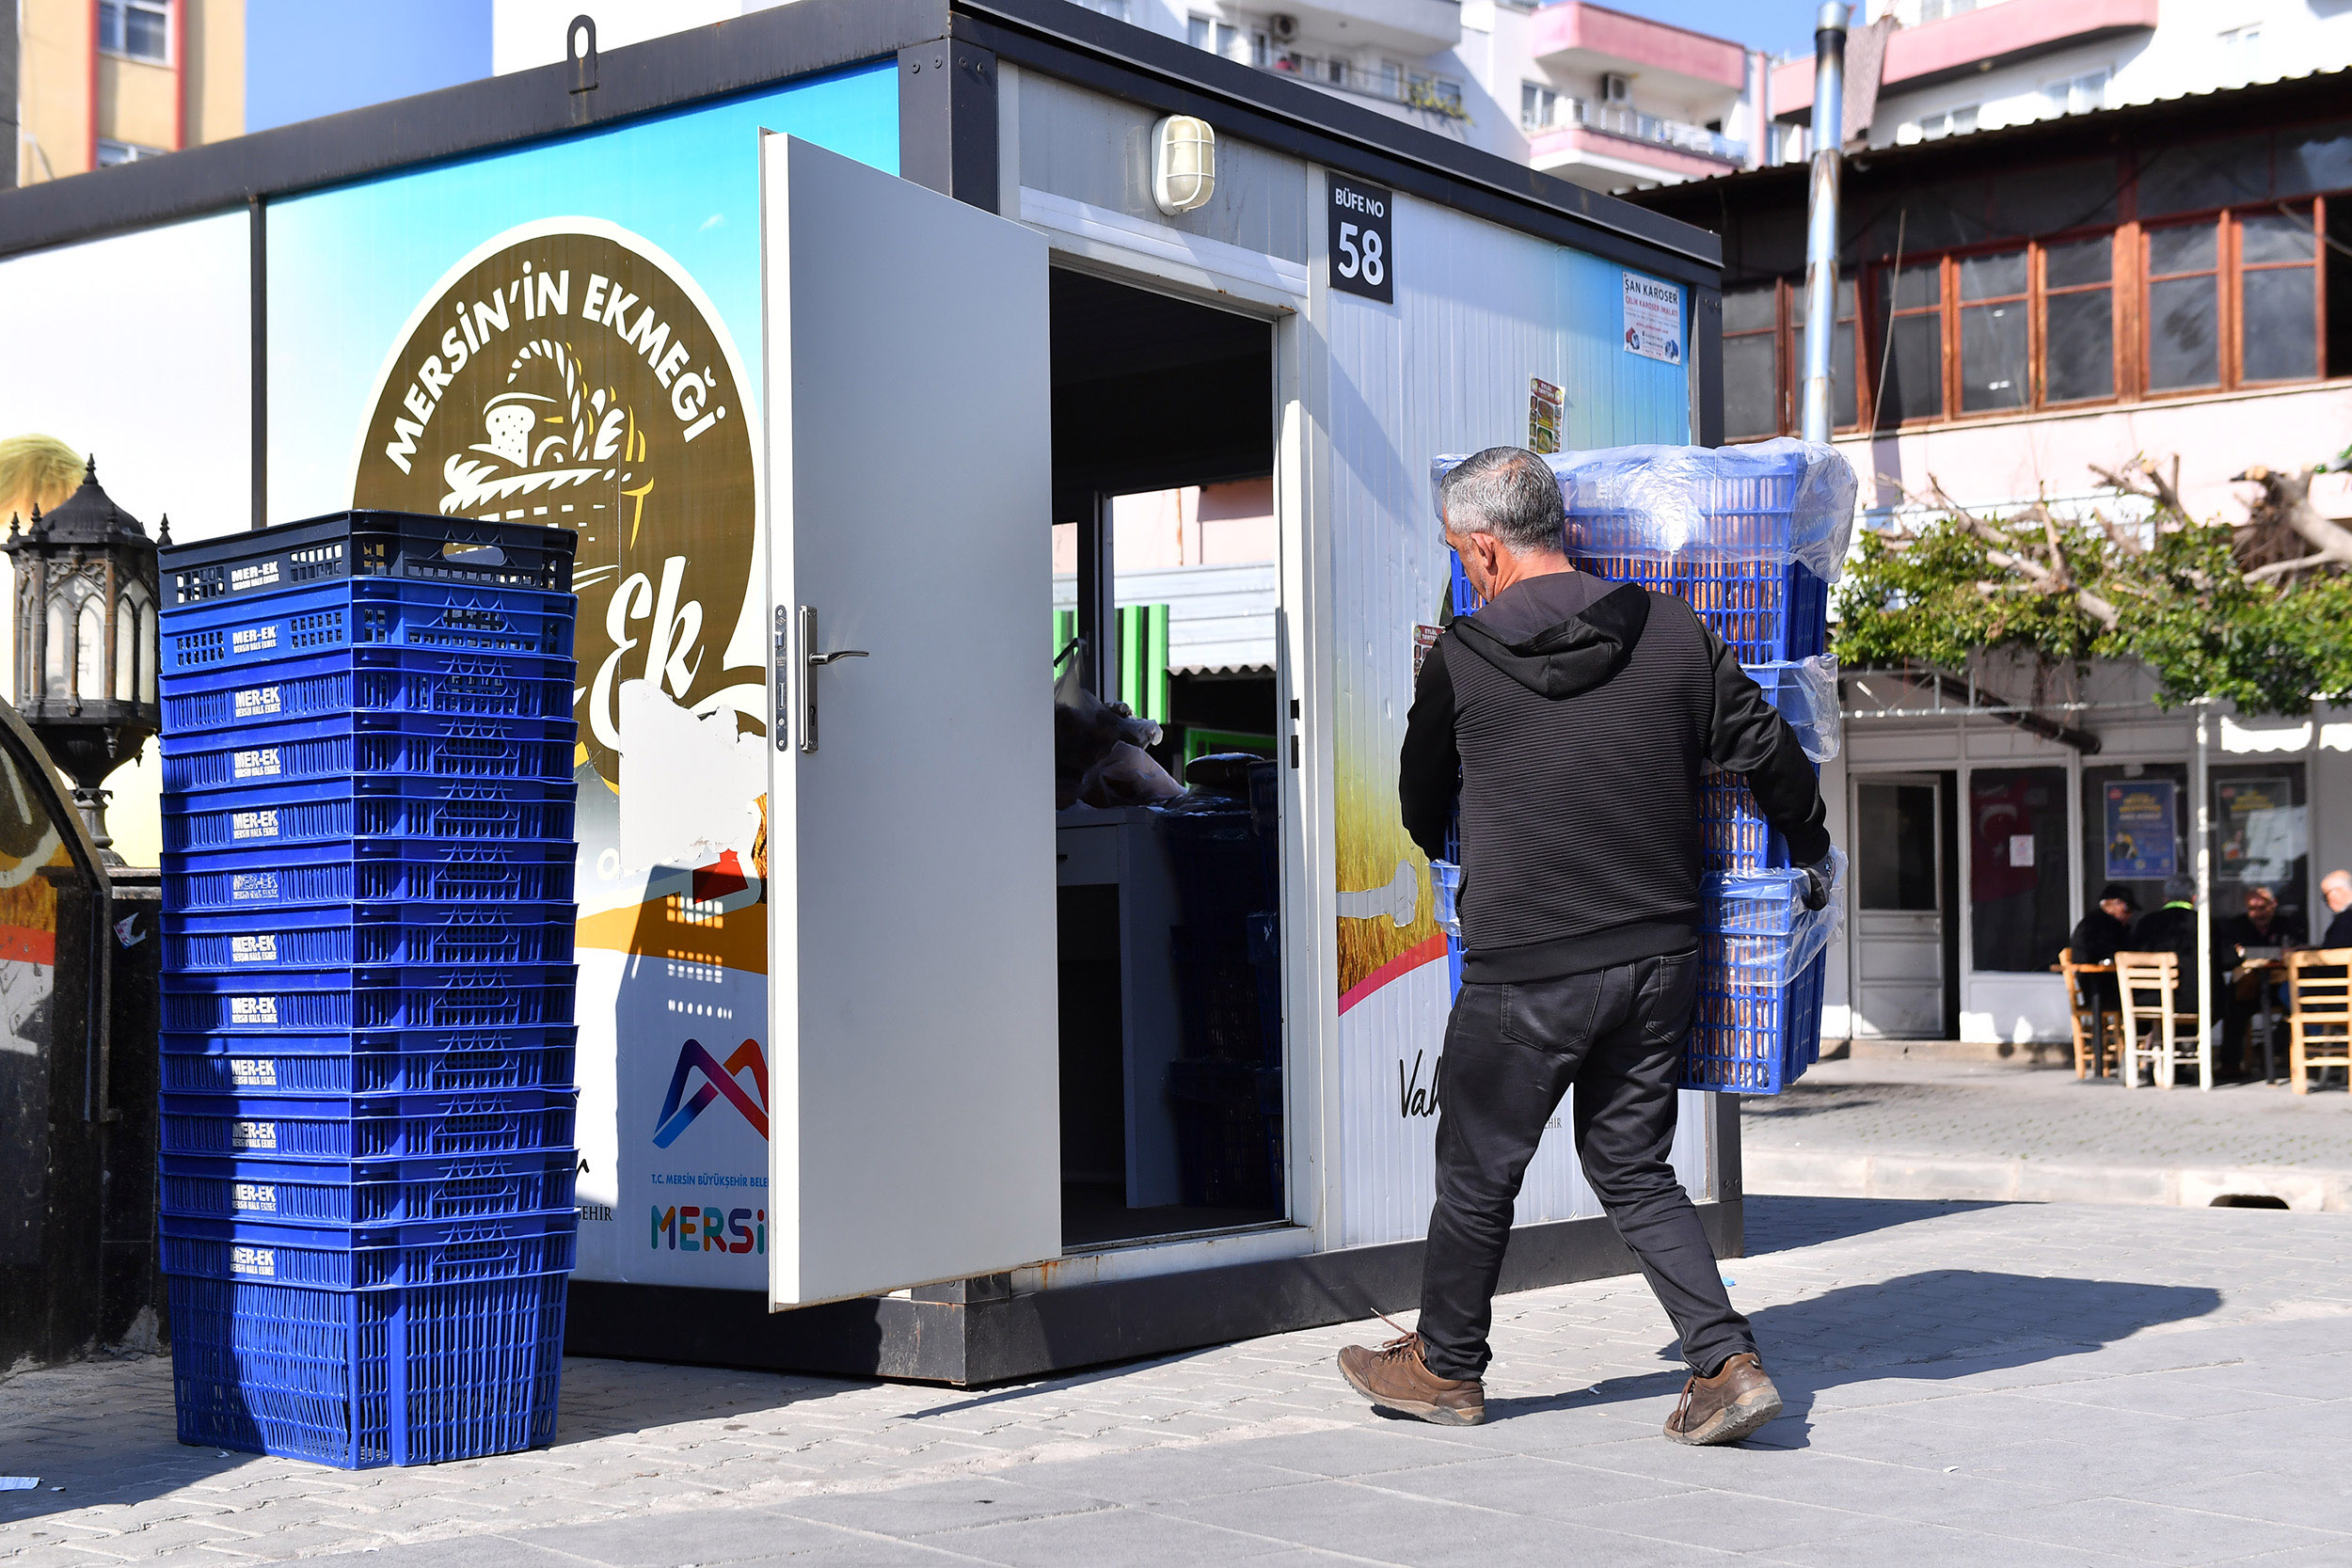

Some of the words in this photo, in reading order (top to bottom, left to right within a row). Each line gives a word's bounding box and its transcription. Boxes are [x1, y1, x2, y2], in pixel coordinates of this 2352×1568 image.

[1335, 187, 1364, 213] BÜFE
[1366, 198, 1385, 218] NO
[1338, 221, 1385, 286] 58
[1643, 284, 1678, 306] KAROSER
[581, 273, 727, 443] EKMEĞİ
[231, 561, 278, 582] MER-EK
[232, 626, 277, 644] MER-EK
[235, 687, 280, 708] MER-EK
[233, 748, 280, 769] MER-EK
[232, 810, 278, 830] MER-EK
[231, 935, 277, 953] MER-EK
[231, 997, 278, 1015] MER-EK
[230, 1059, 276, 1076] MER-EK
[232, 1121, 277, 1139] MER-EK
[651, 1174, 664, 1184] T.C.
[665, 1172, 696, 1185] MERSİN
[697, 1172, 748, 1189] BÜYÜKŞEHİR
[750, 1177, 769, 1187] BELE
[232, 1184, 277, 1202] MER-EK
[651, 1205, 768, 1255] MERSİ
[230, 1246, 275, 1266] MER-EK
